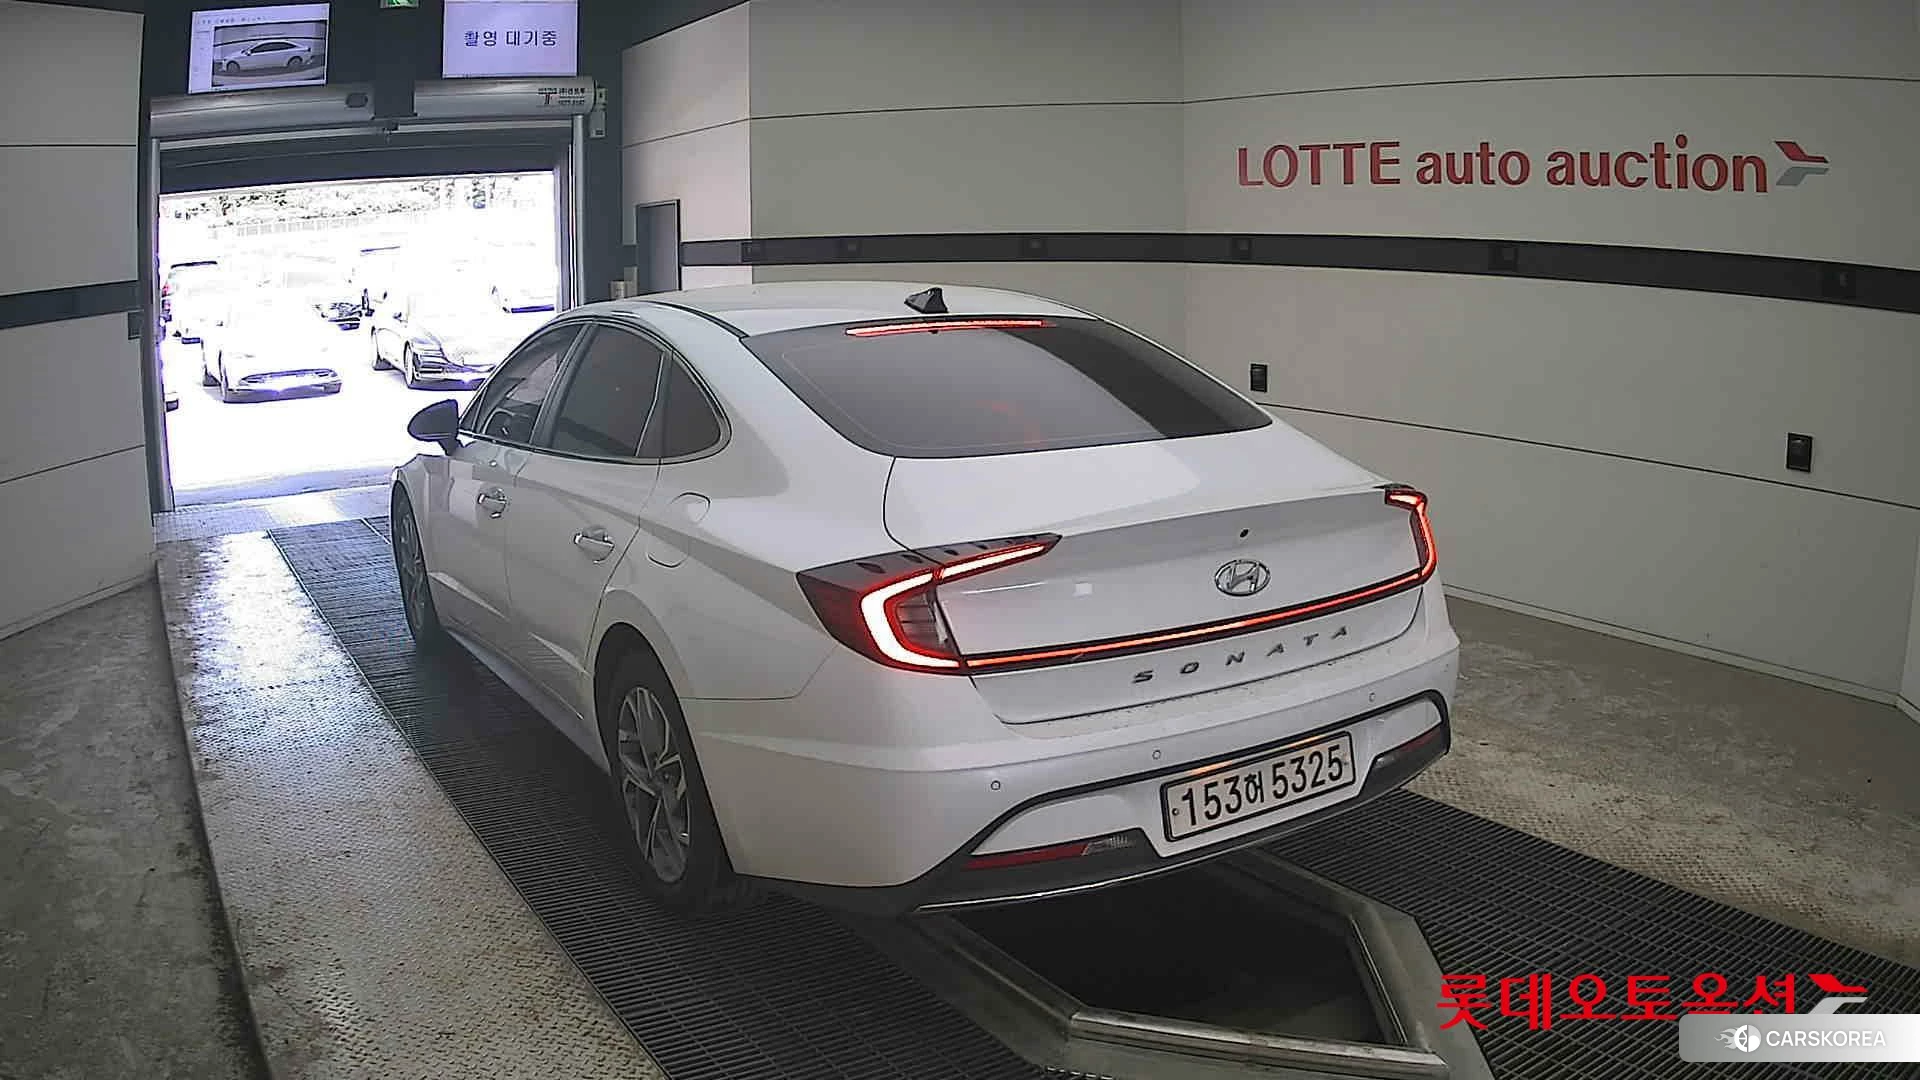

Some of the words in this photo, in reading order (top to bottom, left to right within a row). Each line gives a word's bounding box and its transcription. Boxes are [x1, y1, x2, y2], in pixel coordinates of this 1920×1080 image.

[506, 30, 557, 47] 대기중
[1238, 141, 1401, 188] LOTTE
[1416, 141, 1530, 186] auto
[1546, 134, 1769, 193] auction
[1131, 626, 1348, 684] SONATA
[1271, 744, 1344, 799] 5325
